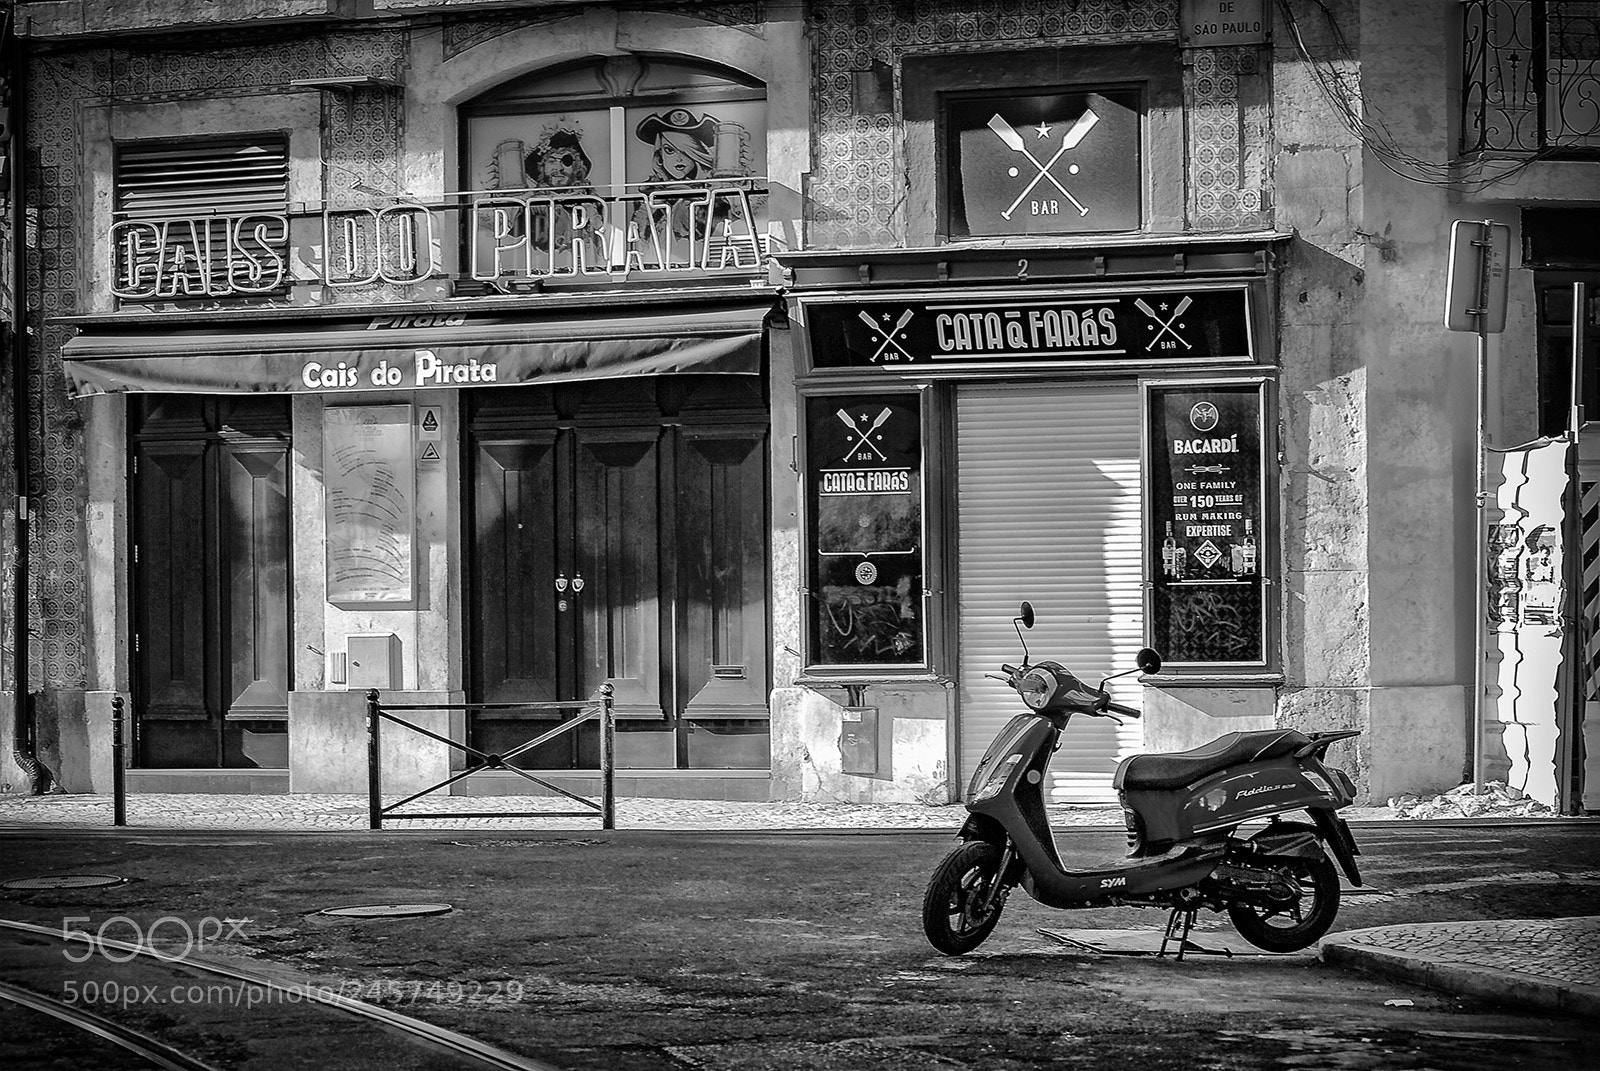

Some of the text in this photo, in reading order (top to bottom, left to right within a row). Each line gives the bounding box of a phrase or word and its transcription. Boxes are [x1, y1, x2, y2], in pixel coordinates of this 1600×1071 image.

[1219, 1, 1235, 13] DE
[1194, 20, 1261, 36] SÃO PAULO
[1031, 200, 1059, 215] BAR
[108, 187, 761, 298] CAIS DO PIRATA
[1017, 258, 1028, 277] 2
[936, 312, 1004, 351] CATA
[1160, 340, 1177, 350] BAR
[884, 352, 899, 361] BAR
[301, 349, 498, 388] Cais do Pirata
[1173, 433, 1239, 454] BACARDÍ
[857, 452, 873, 461] BAR
[823, 472, 856, 492] CATA
[1175, 481, 1236, 490] ONE FAMILY
[1190, 494, 1214, 508] 150
[1175, 512, 1243, 521] RUM MAKING
[1185, 524, 1232, 537] EXPERTISE
[1100, 877, 1126, 889] SYM
